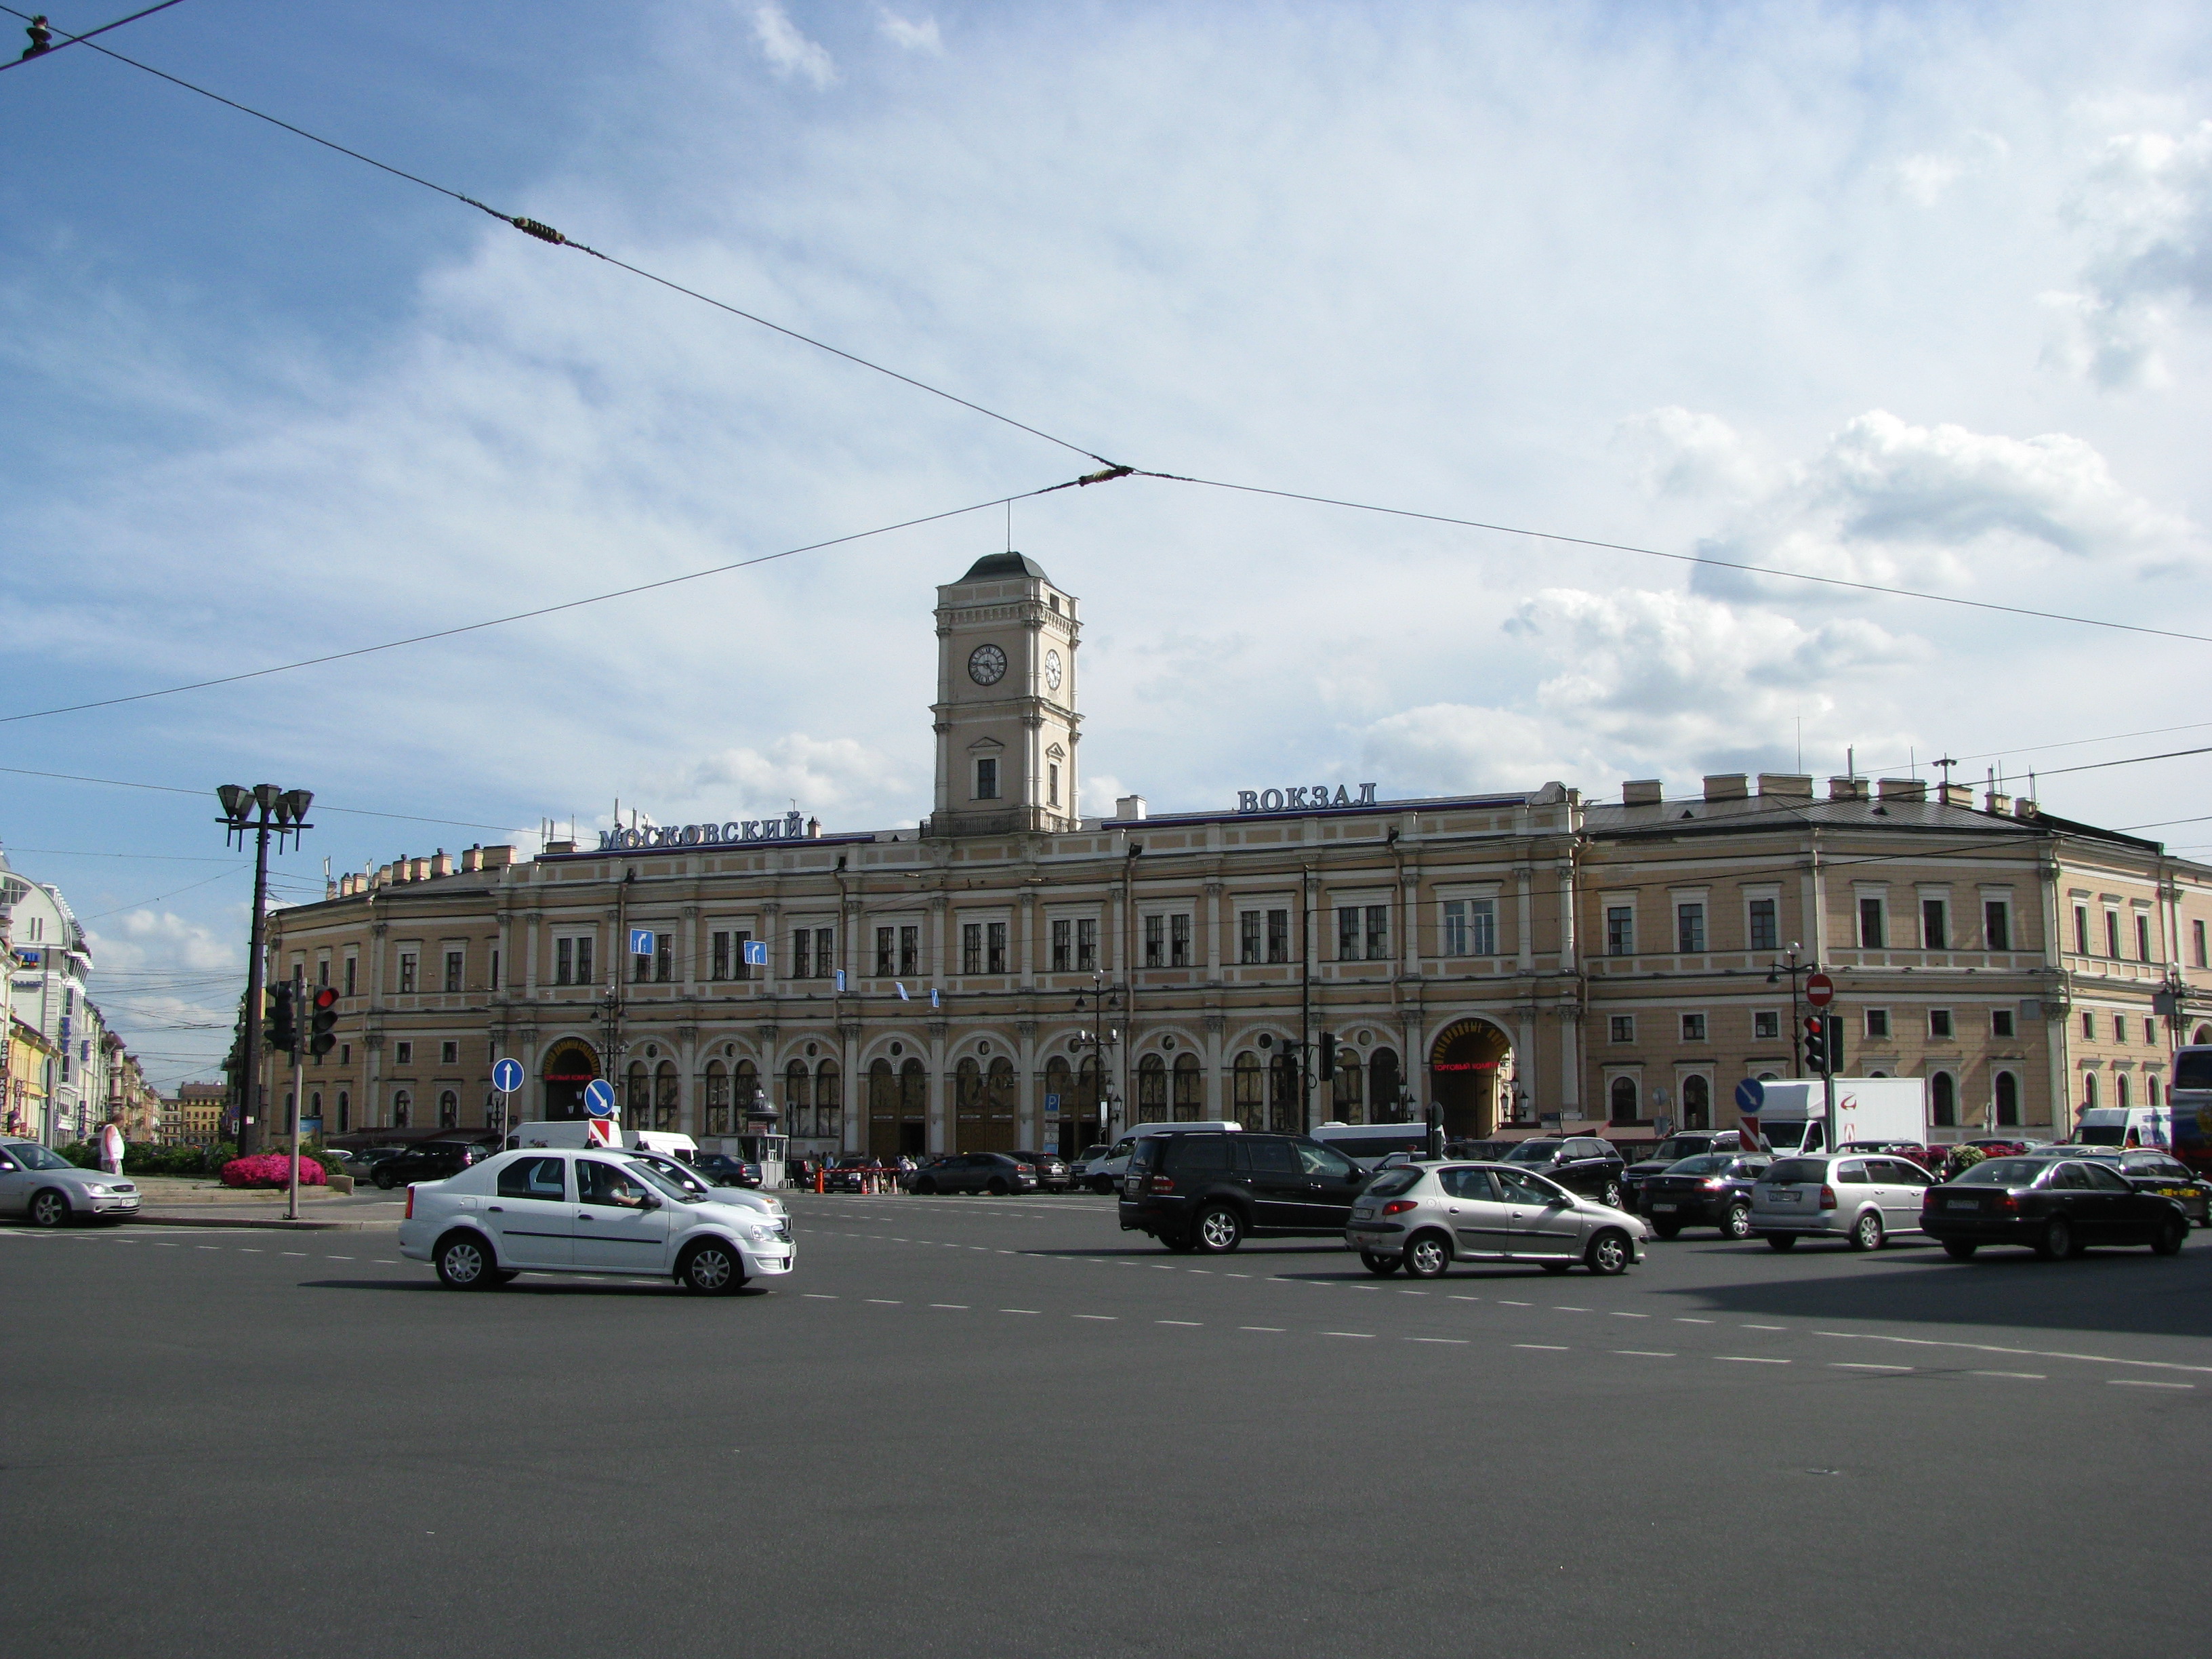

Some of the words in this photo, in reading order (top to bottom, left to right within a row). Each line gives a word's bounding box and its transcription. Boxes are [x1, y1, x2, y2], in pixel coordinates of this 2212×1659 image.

[1237, 783, 1376, 813] ВОКЗАЛ
[599, 811, 804, 851] МОСКОВСКИЙ
[1434, 1063, 1471, 1071] ТОРГОВЫЙ
